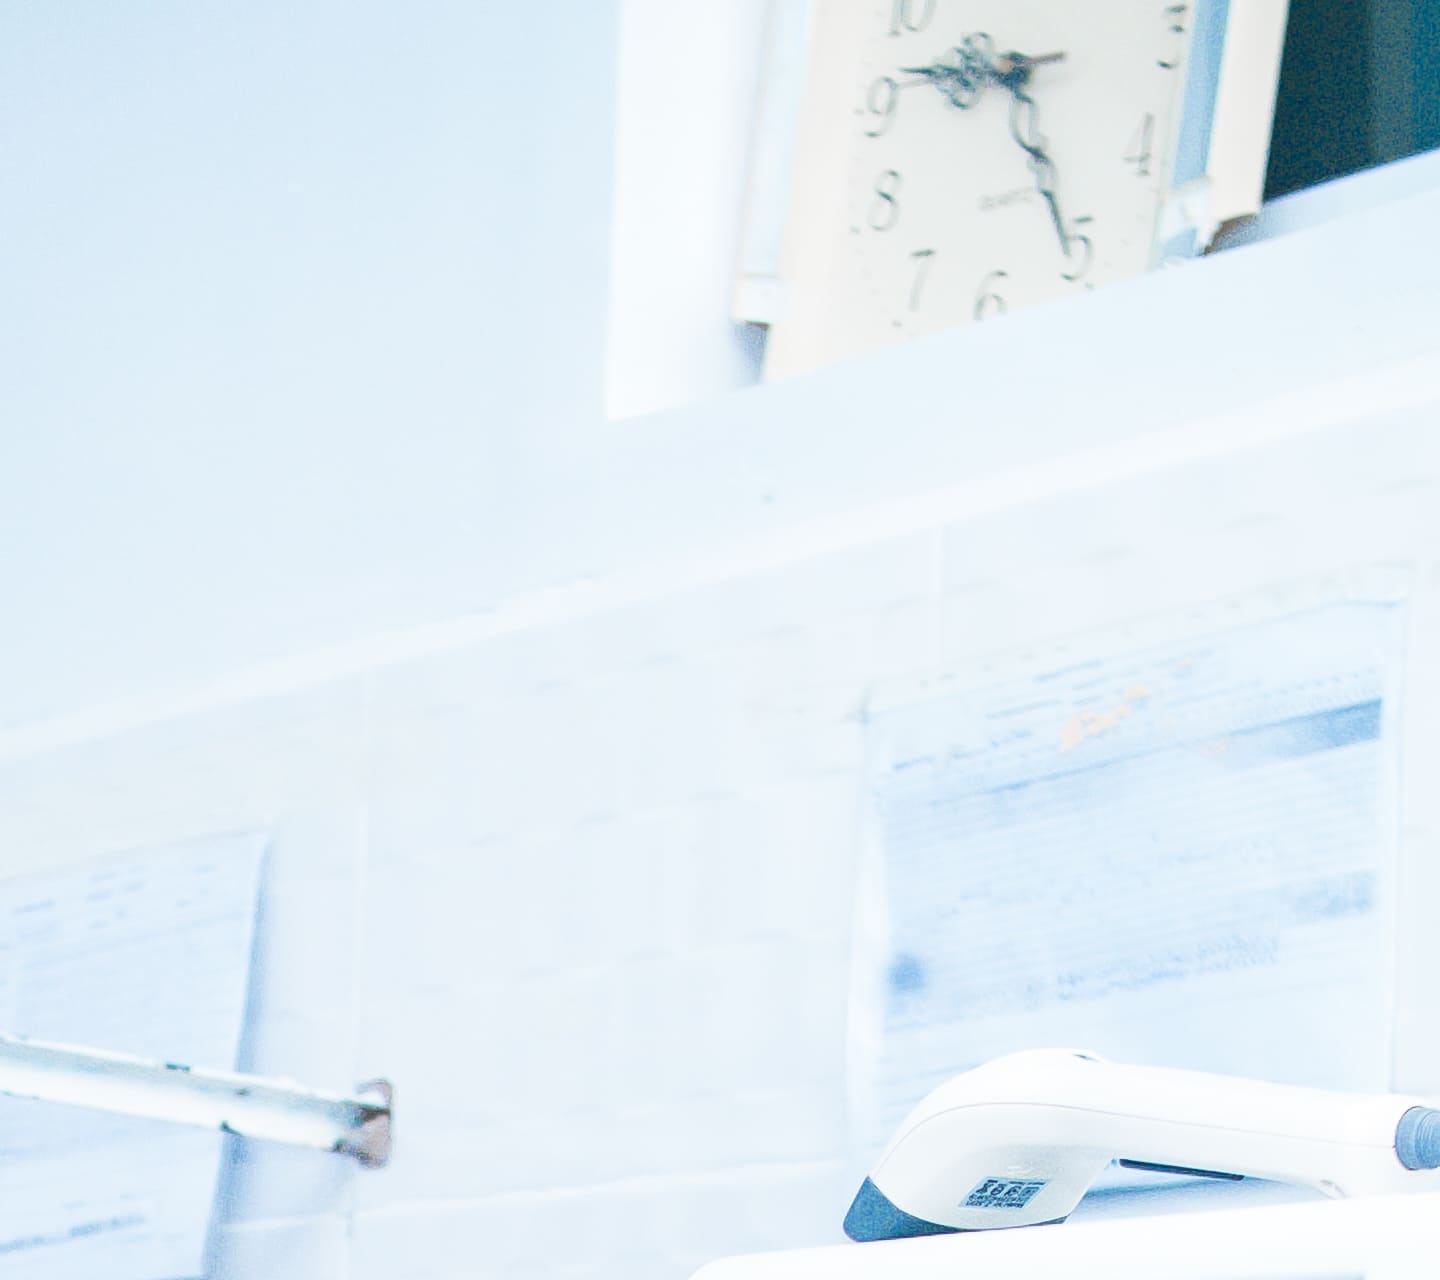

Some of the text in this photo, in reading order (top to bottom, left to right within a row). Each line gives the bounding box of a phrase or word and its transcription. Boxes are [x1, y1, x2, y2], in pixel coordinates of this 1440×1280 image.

[864, 77, 900, 137] 9
[1123, 112, 1155, 177] 4
[867, 170, 901, 231] 8
[910, 248, 936, 311] 7
